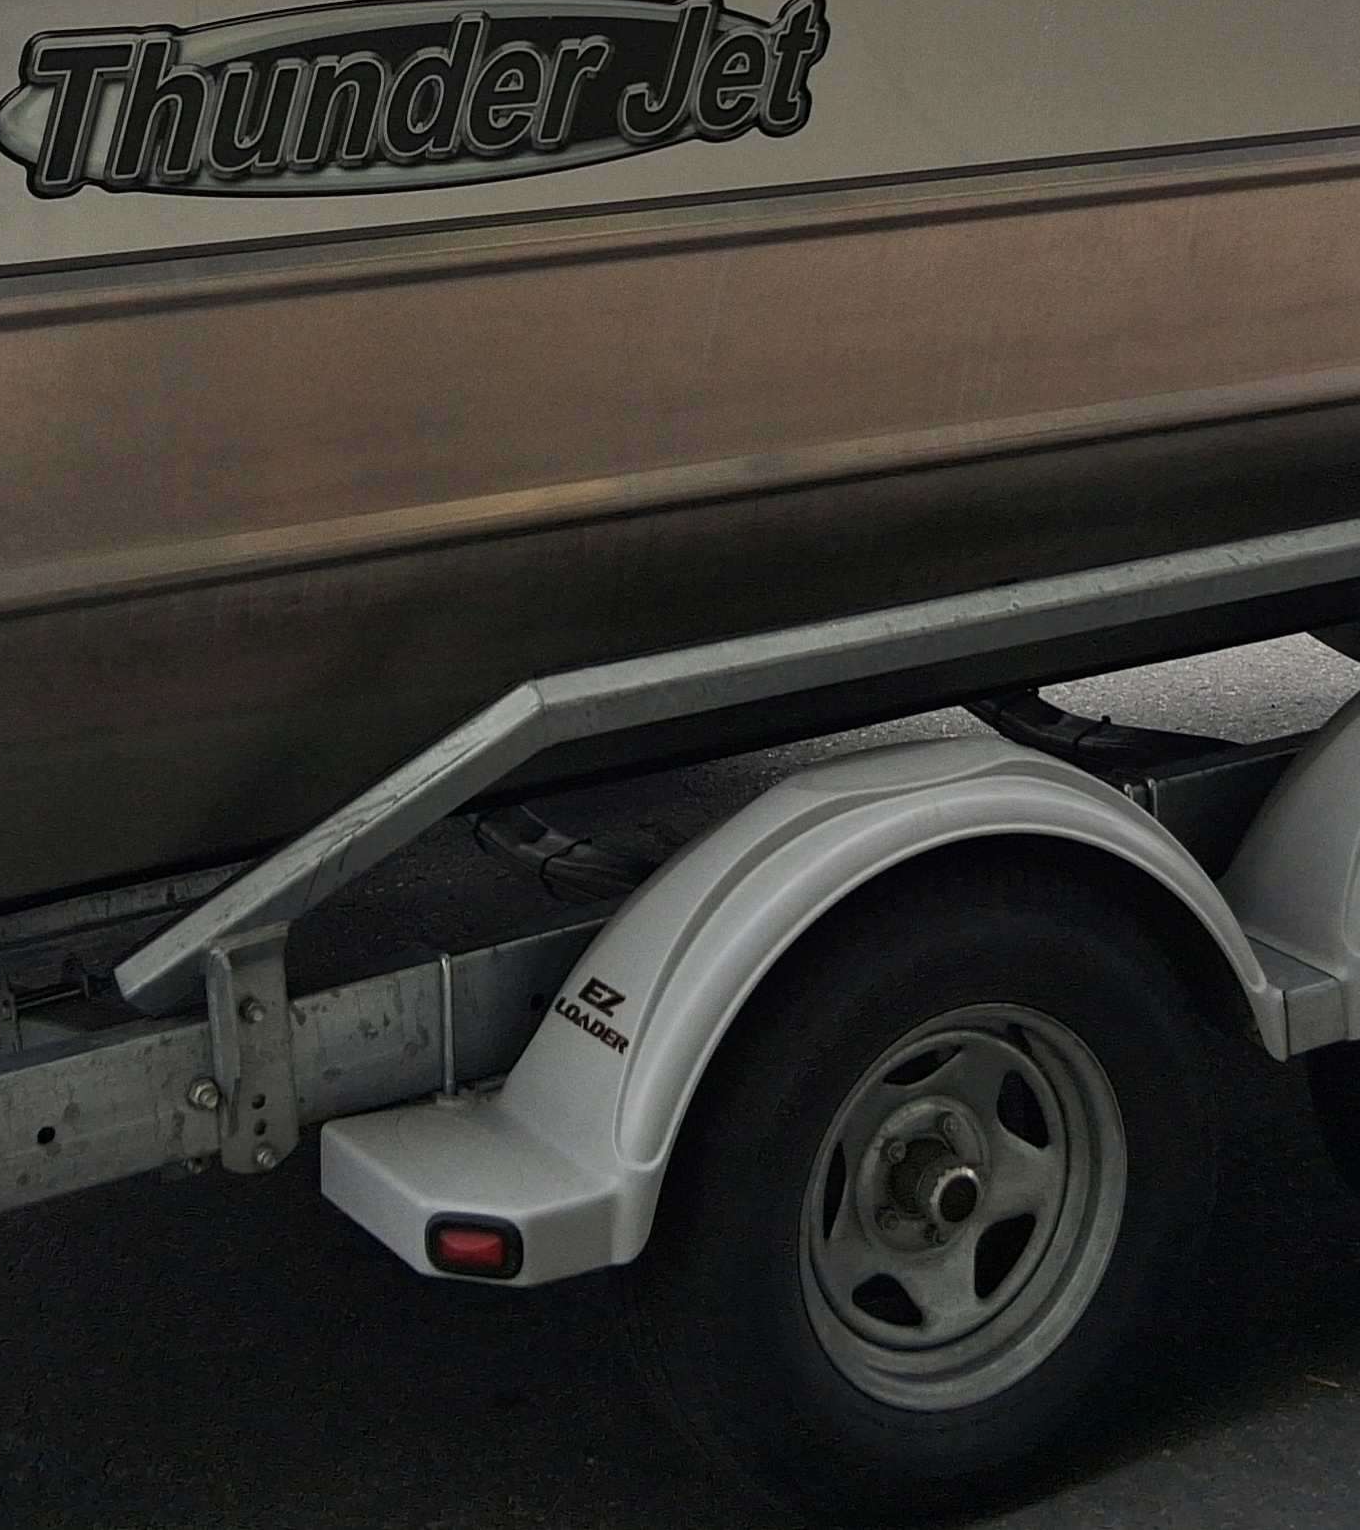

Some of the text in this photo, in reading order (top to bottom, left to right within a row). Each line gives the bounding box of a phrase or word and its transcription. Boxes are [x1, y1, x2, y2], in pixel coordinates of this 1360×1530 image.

[30, 10, 613, 190] Thunder
[554, 996, 630, 1055] LOADER
[578, 976, 626, 1018] EZ
